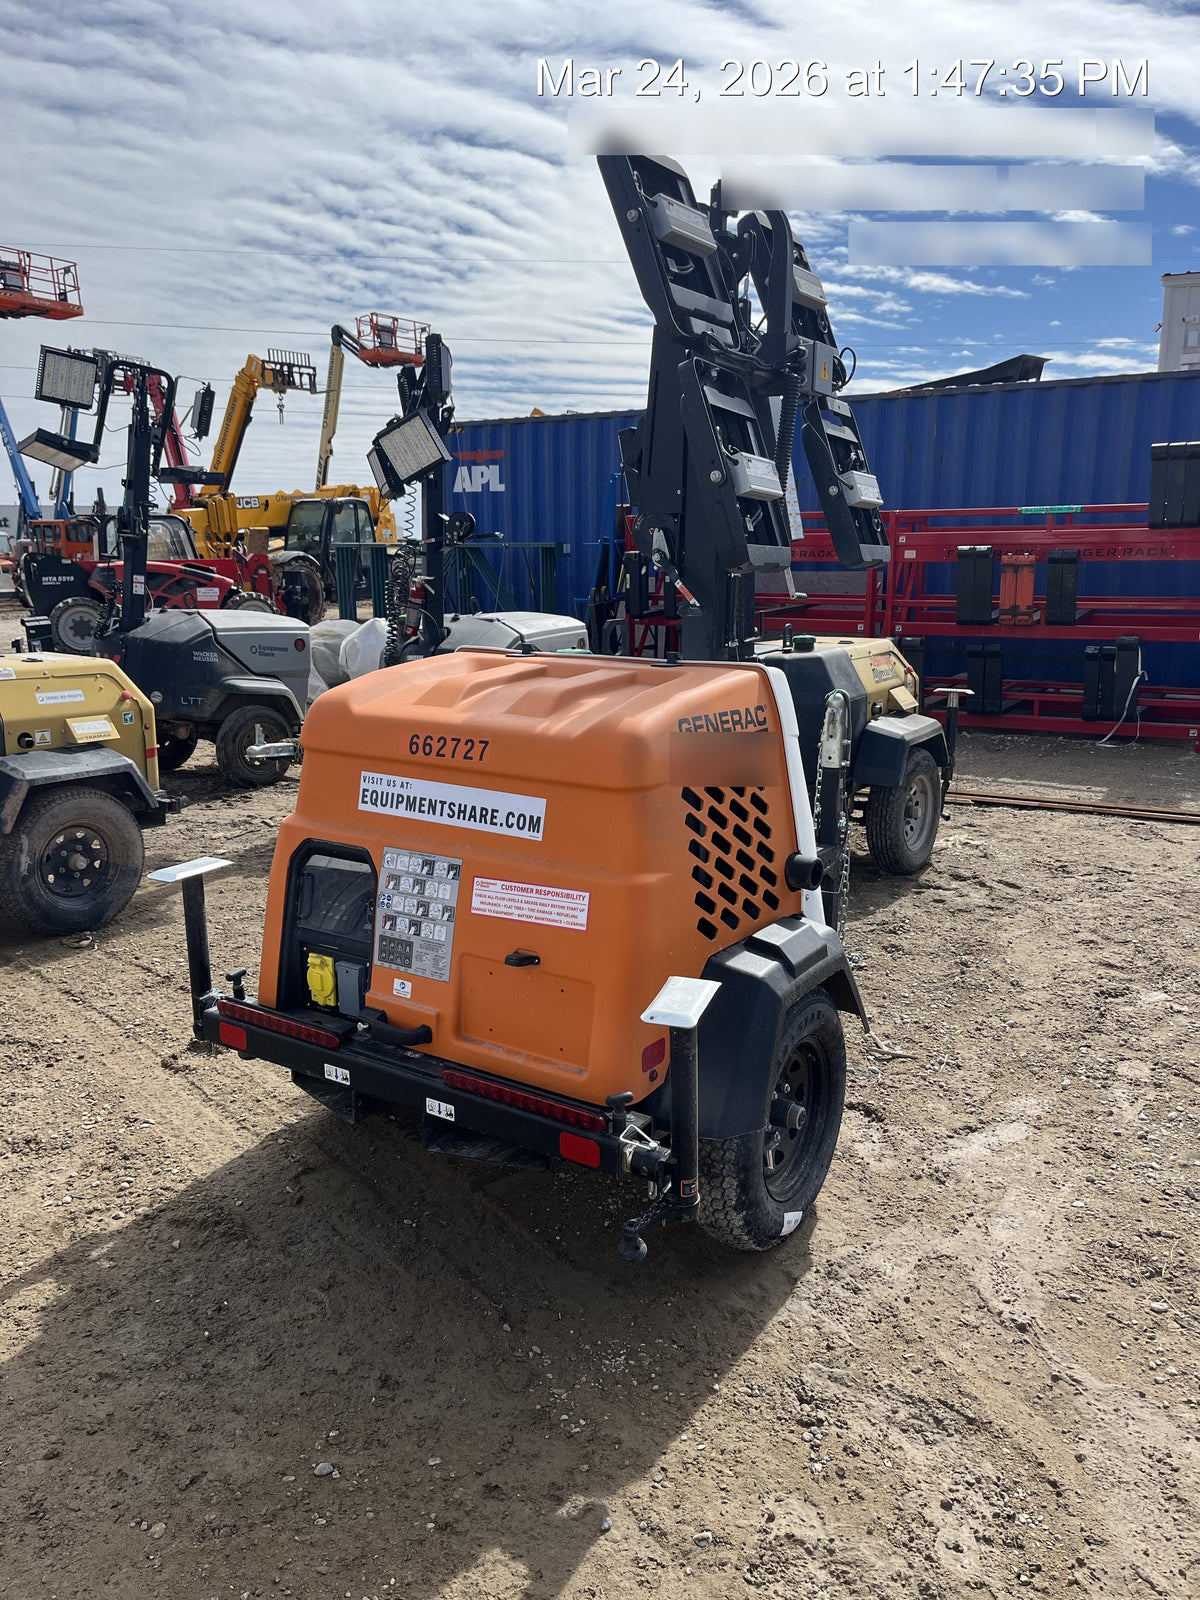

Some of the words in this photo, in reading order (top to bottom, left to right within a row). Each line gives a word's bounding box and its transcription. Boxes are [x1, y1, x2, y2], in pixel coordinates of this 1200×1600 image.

[214, 396, 238, 472] EquipmentShare
[453, 465, 506, 493] APL
[237, 498, 260, 509] JCB
[800, 550, 835, 558] RACK
[1123, 547, 1170, 557] RACK
[259, 645, 289, 653] Equipment
[409, 734, 490, 761] 662727
[362, 775, 384, 786] VISIT
[386, 779, 397, 788] US
[399, 781, 413, 790] AT:
[361, 787, 542, 834] EQUIPMENTSHARE.COM
[501, 884, 534, 894] CUSTOMER
[535, 888, 586, 901] RESPONSIBILITY
[493, 909, 514, 917] EQUIPMENT
[534, 915, 562, 924] MAINTENANCE
